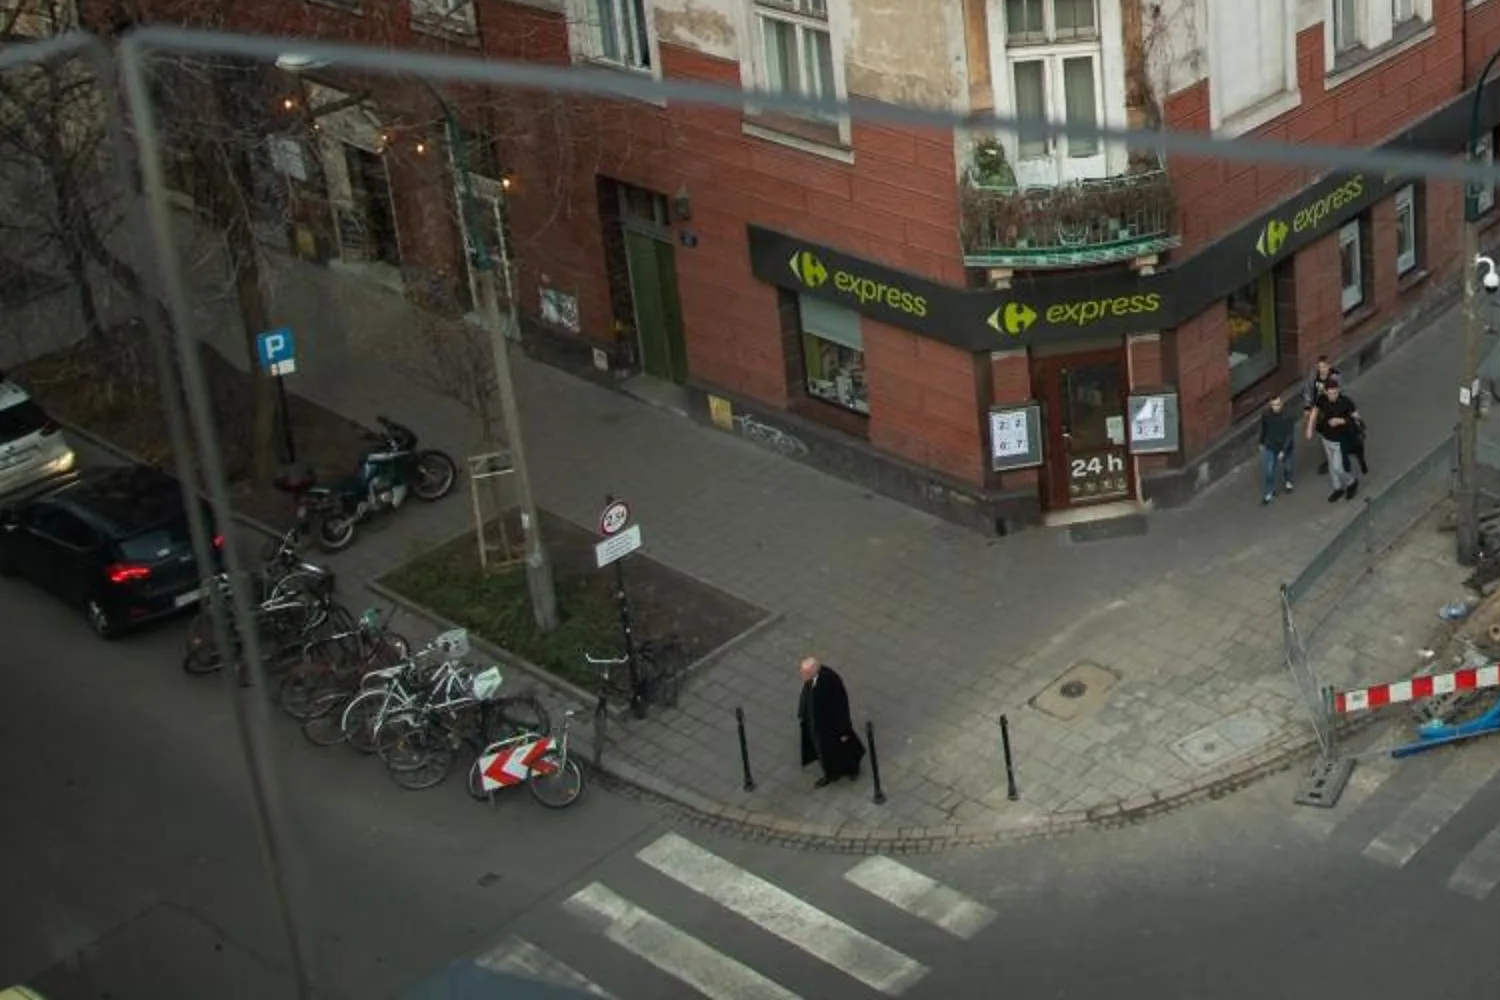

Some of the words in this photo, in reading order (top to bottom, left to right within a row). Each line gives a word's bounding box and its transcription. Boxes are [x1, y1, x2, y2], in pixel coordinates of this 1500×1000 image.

[1293, 174, 1363, 233] express
[833, 270, 928, 317] express
[1046, 292, 1161, 325] express
[265, 333, 285, 360] P
[1071, 456, 1104, 478] 24
[1107, 453, 1124, 472] h
